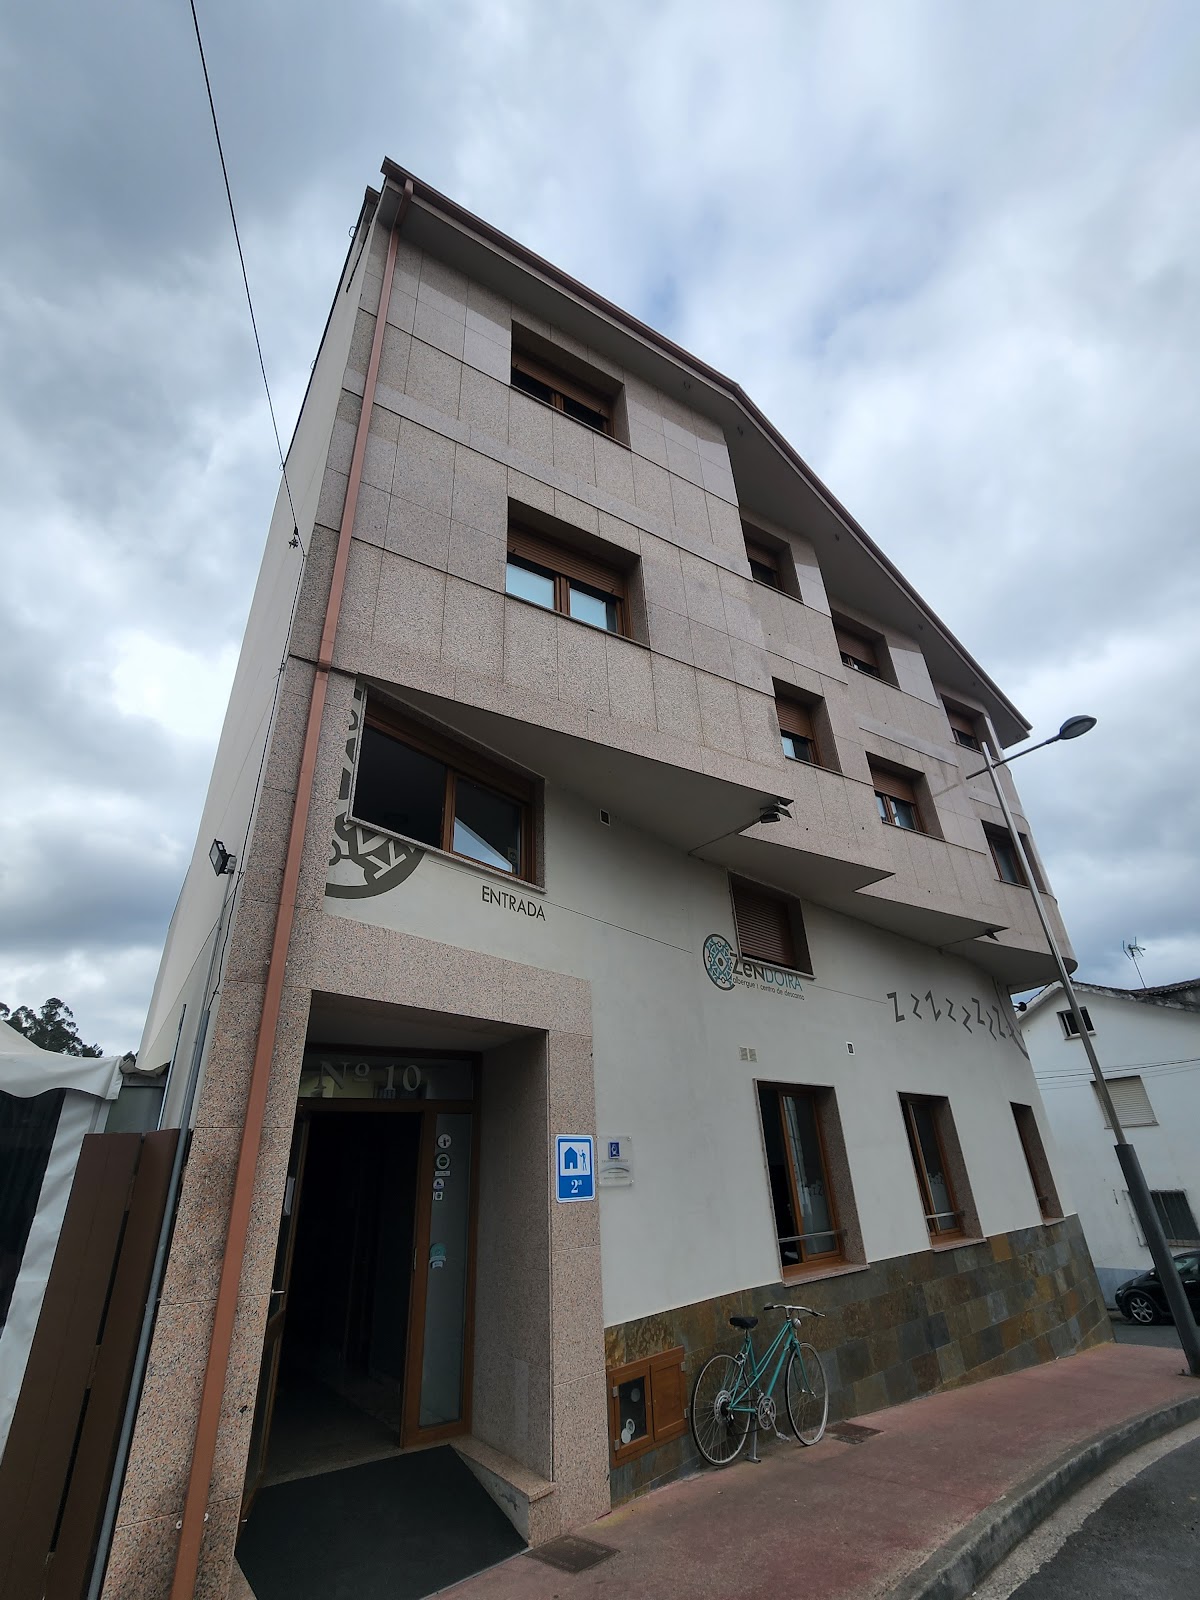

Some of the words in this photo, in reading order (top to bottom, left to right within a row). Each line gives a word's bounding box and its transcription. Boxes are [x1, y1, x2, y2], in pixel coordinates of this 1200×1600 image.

[481, 885, 546, 921] ENTRADA
[732, 976, 756, 989] albergue
[760, 984, 776, 994] centro
[384, 1064, 422, 1092] 10
